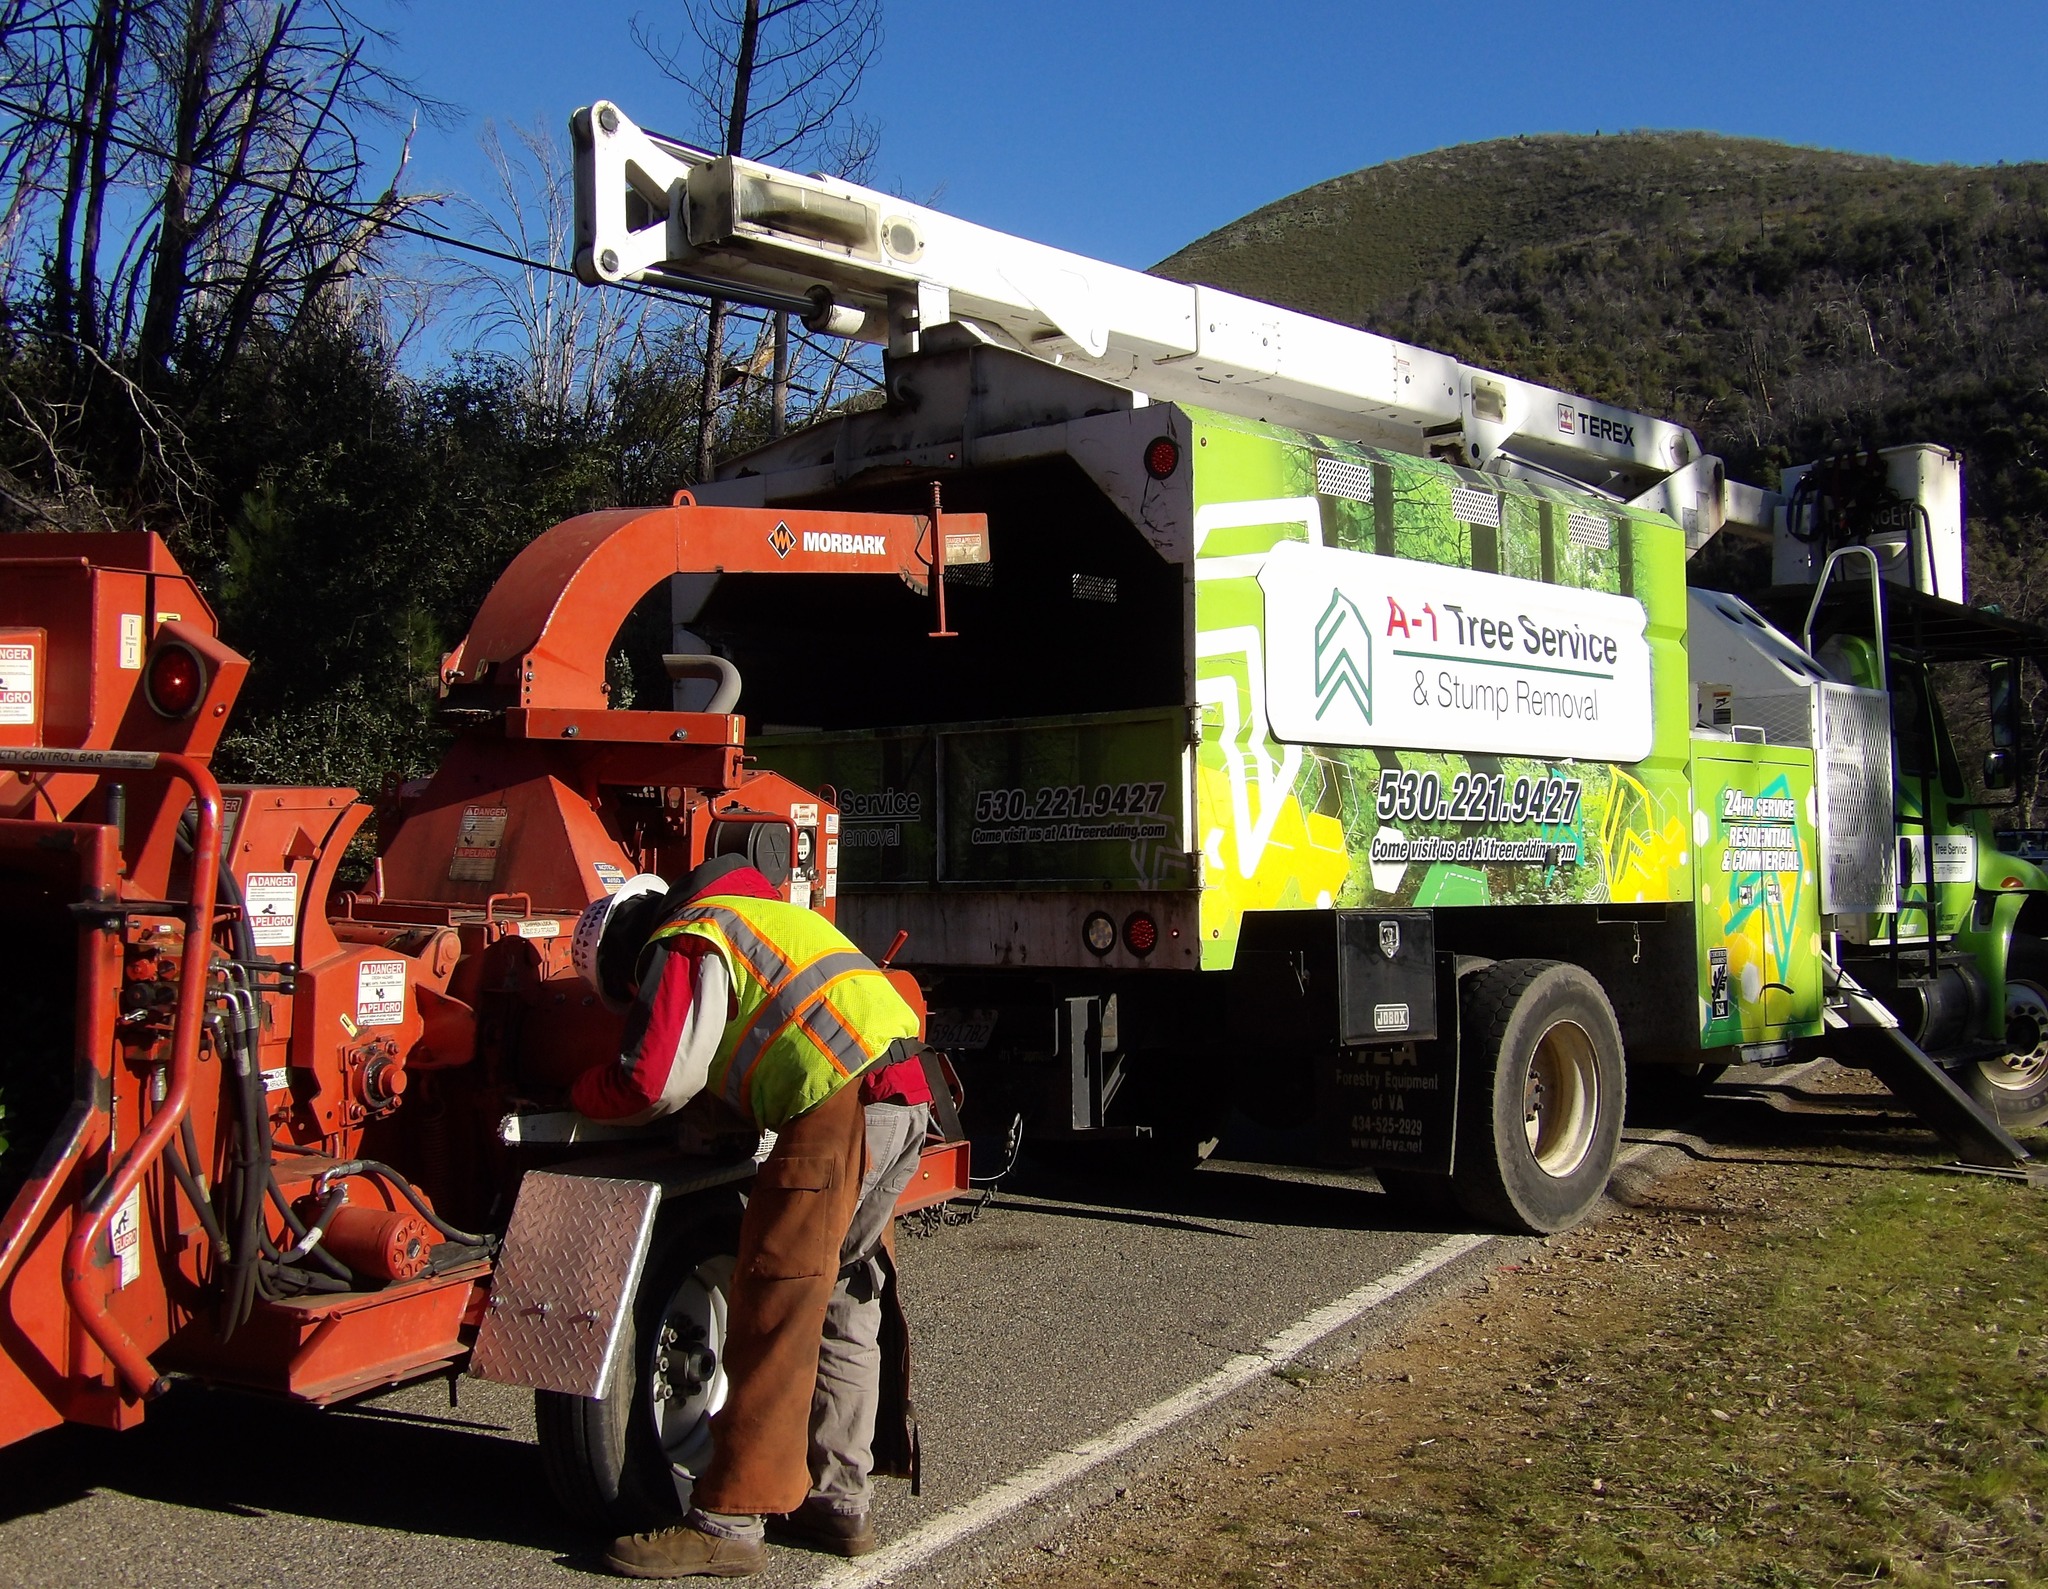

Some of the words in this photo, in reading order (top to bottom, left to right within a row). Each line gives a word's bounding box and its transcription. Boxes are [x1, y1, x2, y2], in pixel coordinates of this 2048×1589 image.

[1578, 412, 1635, 448] TEREX
[803, 531, 886, 556] MORBARK
[1386, 596, 1438, 642] A-1
[1443, 604, 1514, 651] Tree
[1517, 614, 1618, 665] Service
[0, 692, 30, 703] IGRO
[1413, 669, 1430, 706] &
[1437, 671, 1509, 721] Stump
[1516, 679, 1599, 721] Removal
[23, 750, 75, 763] CONTROL
[79, 753, 103, 763] BAR
[841, 788, 920, 815] Service
[976, 782, 1166, 822] 530.221.9427
[1377, 769, 1582, 823] 530.221.9427
[1724, 788, 1754, 817] 24HR
[1755, 798, 1794, 819] SERVICE
[473, 807, 507, 817] DANGER
[973, 828, 1001, 845] Come
[1003, 826, 1027, 842] visit
[1029, 828, 1042, 841] us
[1044, 826, 1057, 840] at
[1059, 822, 1166, 841] A1treeredding.com
[1728, 825, 1792, 849] RESIDENTIAL
[464, 849, 497, 858] PELIGRO
[1371, 838, 1408, 861] Come
[1409, 837, 1440, 861] visit
[1440, 841, 1458, 861] us
[1458, 838, 1472, 861] at
[1934, 842, 1947, 855] Tree
[1947, 842, 1968, 855] Service
[1721, 849, 1731, 872] &
[1732, 849, 1800, 873] COMMERCIAL
[257, 876, 294, 887] DANGER
[255, 916, 293, 927] PELIGRO
[370, 963, 402, 974] DANGER
[367, 1002, 401, 1013] PELIGRO
[1377, 1011, 1406, 1025] JOBOX
[1335, 1069, 1381, 1090] Forestry
[1384, 1071, 1439, 1092] Equipment
[1371, 1094, 1383, 1110] of
[1388, 1095, 1405, 1112] VA
[1351, 1115, 1423, 1137] 434-525-2929
[1350, 1135, 1423, 1153] www.feva.net
